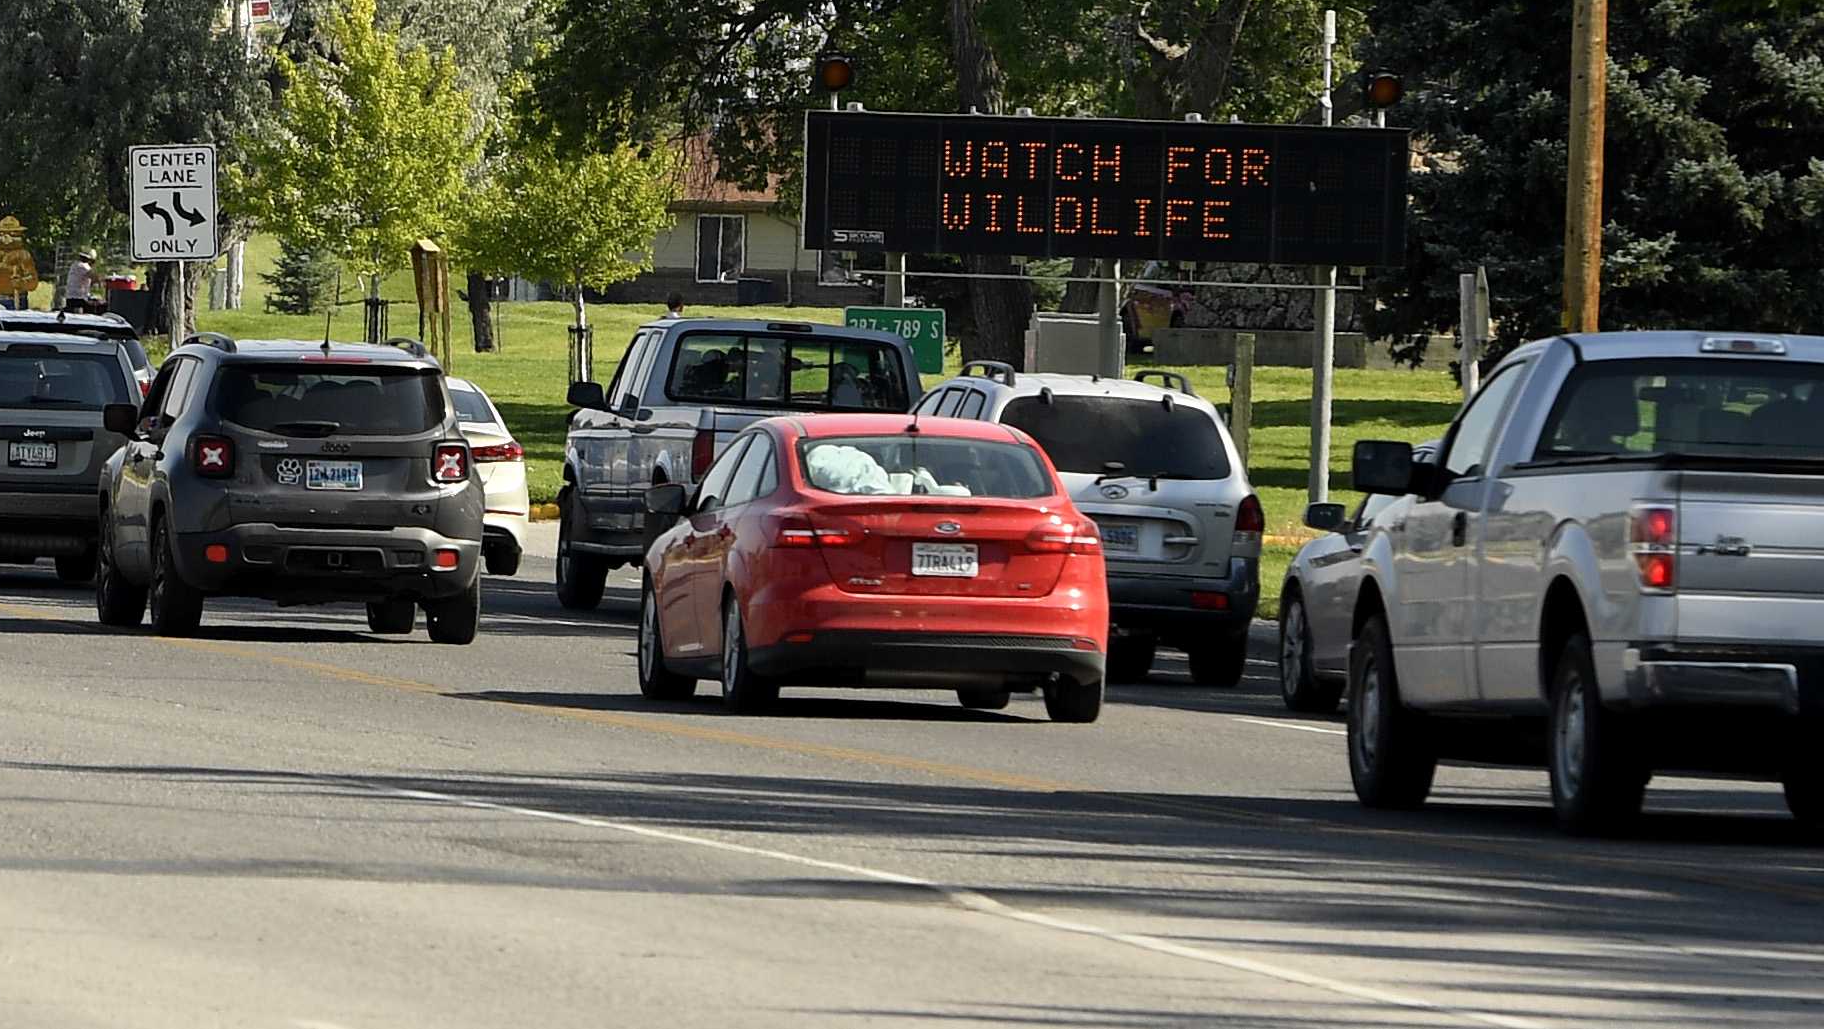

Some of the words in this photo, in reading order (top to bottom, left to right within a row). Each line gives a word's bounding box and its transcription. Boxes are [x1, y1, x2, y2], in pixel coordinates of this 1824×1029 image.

[138, 152, 206, 167] CENTER
[943, 139, 1122, 183] WATCH
[1166, 146, 1271, 186] FOR
[149, 169, 197, 183] LANE
[942, 192, 1231, 239] WILDLIFE
[149, 238, 198, 253] ONLY
[930, 321, 939, 339] S
[23, 428, 46, 438] Jeep
[321, 441, 351, 453] Jeep
